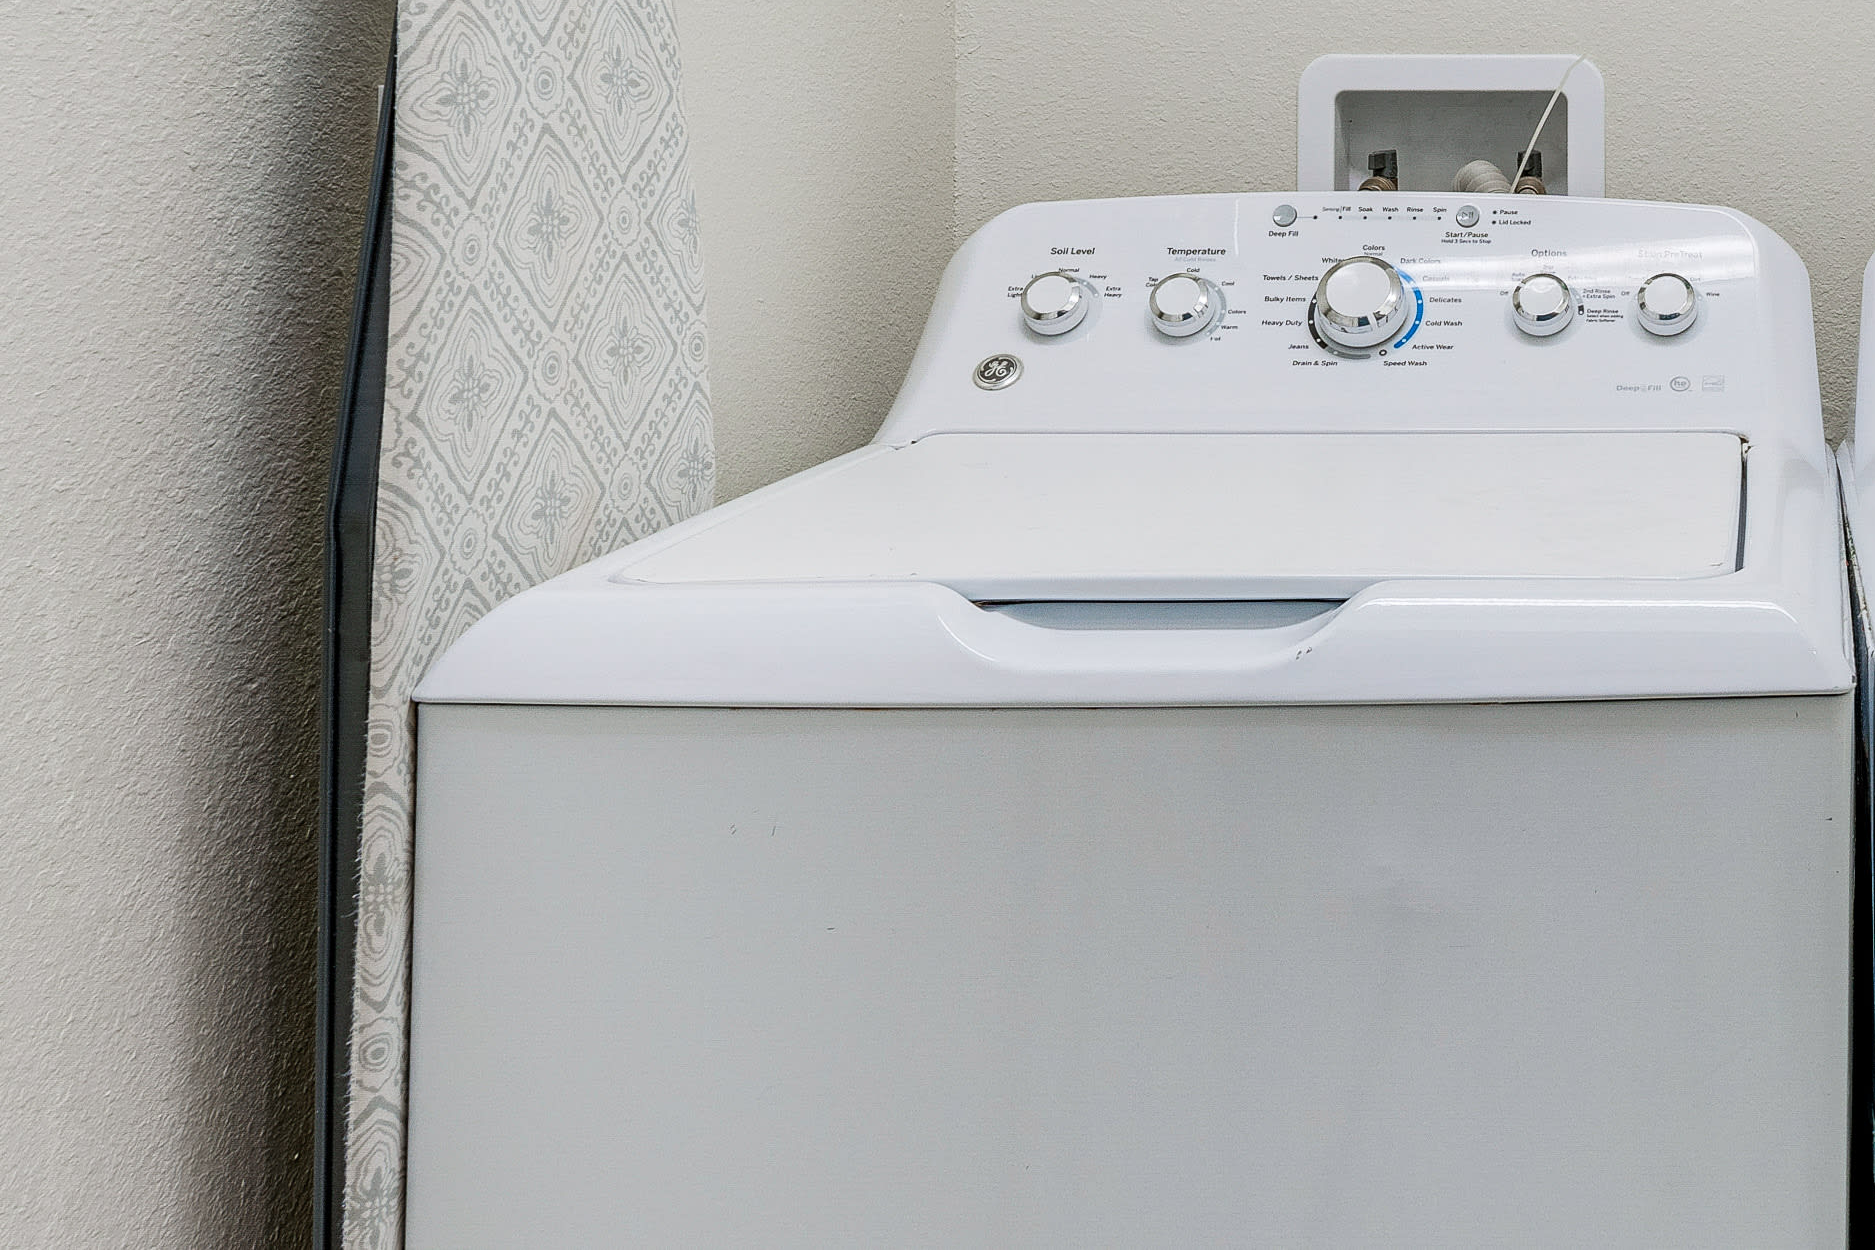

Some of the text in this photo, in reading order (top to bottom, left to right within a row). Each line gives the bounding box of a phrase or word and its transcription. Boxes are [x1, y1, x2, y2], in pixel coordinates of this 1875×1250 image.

[1268, 230, 1287, 238] Deep
[1050, 247, 1096, 255] Soil Level
[1167, 247, 1226, 256] Temperature
[1531, 249, 1568, 258] Options
[1261, 319, 1303, 327] Heavy Duty
[1616, 384, 1640, 392] Deep
